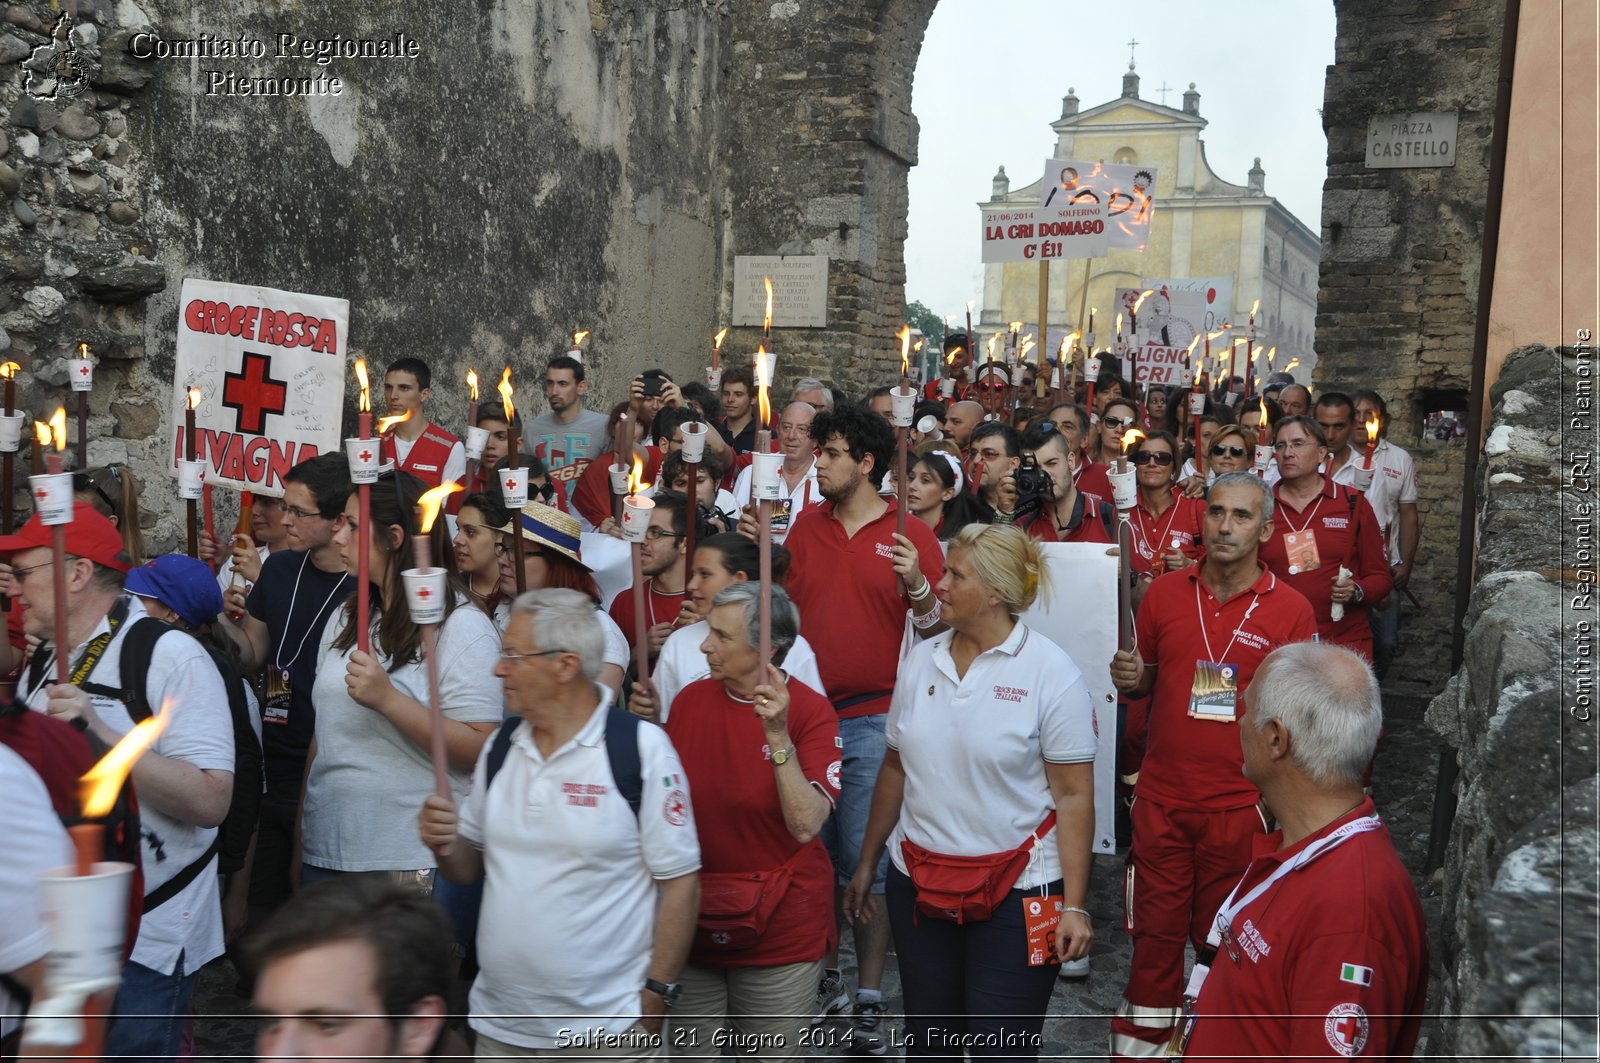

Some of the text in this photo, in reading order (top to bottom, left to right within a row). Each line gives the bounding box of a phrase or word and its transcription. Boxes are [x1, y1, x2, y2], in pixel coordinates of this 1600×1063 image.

[1391, 122, 1433, 136] PIAZZA
[1372, 141, 1449, 157] CASTELLO
[987, 211, 1034, 222] 21/06/2014
[1058, 208, 1101, 218] SOLFERINO
[986, 220, 1105, 241] LA CRI DOMASO
[1041, 240, 1063, 258] É!!
[185, 299, 337, 355] CROCE ROSSA
[1134, 365, 1173, 383] CRI
[1232, 628, 1270, 647] CROCE ROSSA
[1236, 636, 1263, 650] ITALIANA
[69, 656, 96, 686] Nikon
[994, 692, 1022, 703] ITALIANA
